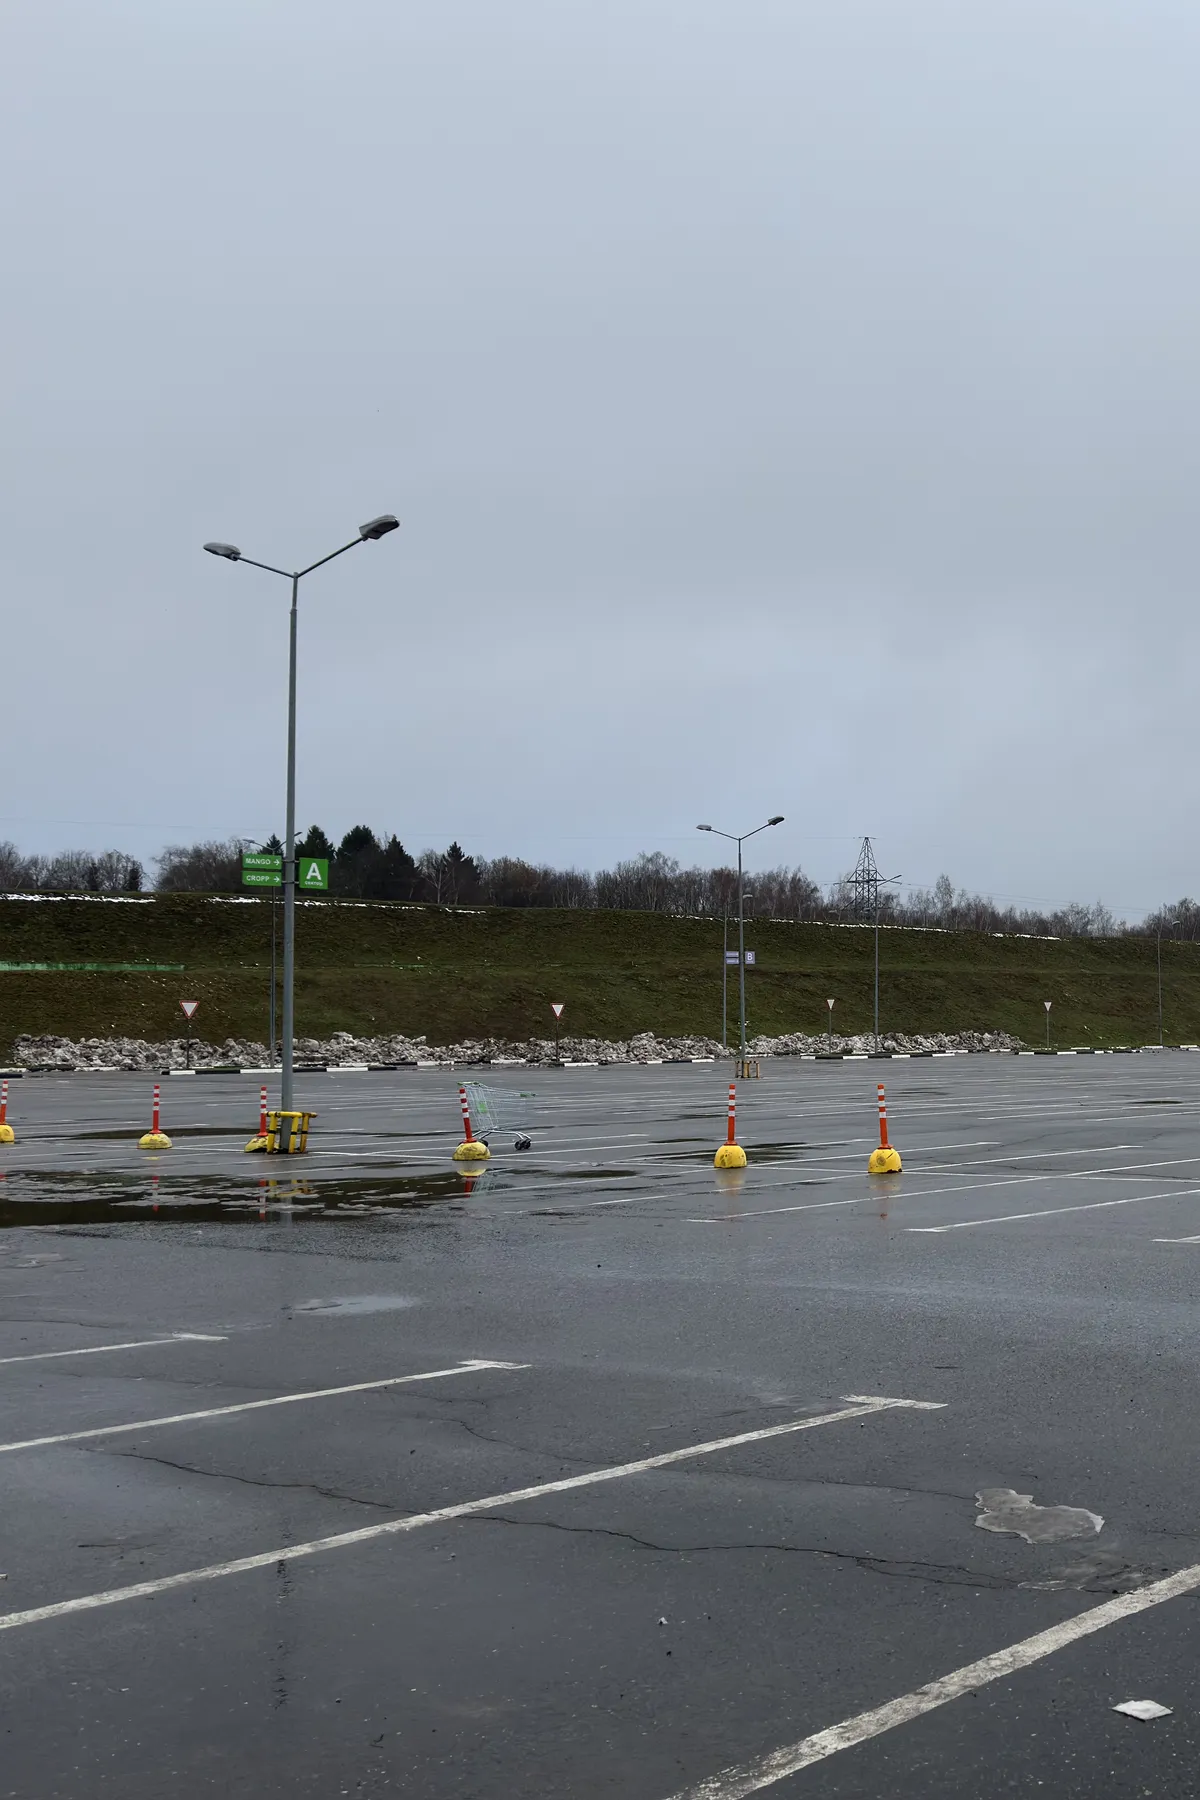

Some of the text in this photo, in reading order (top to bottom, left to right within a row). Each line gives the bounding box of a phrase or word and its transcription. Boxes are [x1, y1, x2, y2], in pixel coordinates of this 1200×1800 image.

[245, 857, 271, 866] MANGO
[306, 862, 322, 881] A
[246, 874, 270, 882] CROPP
